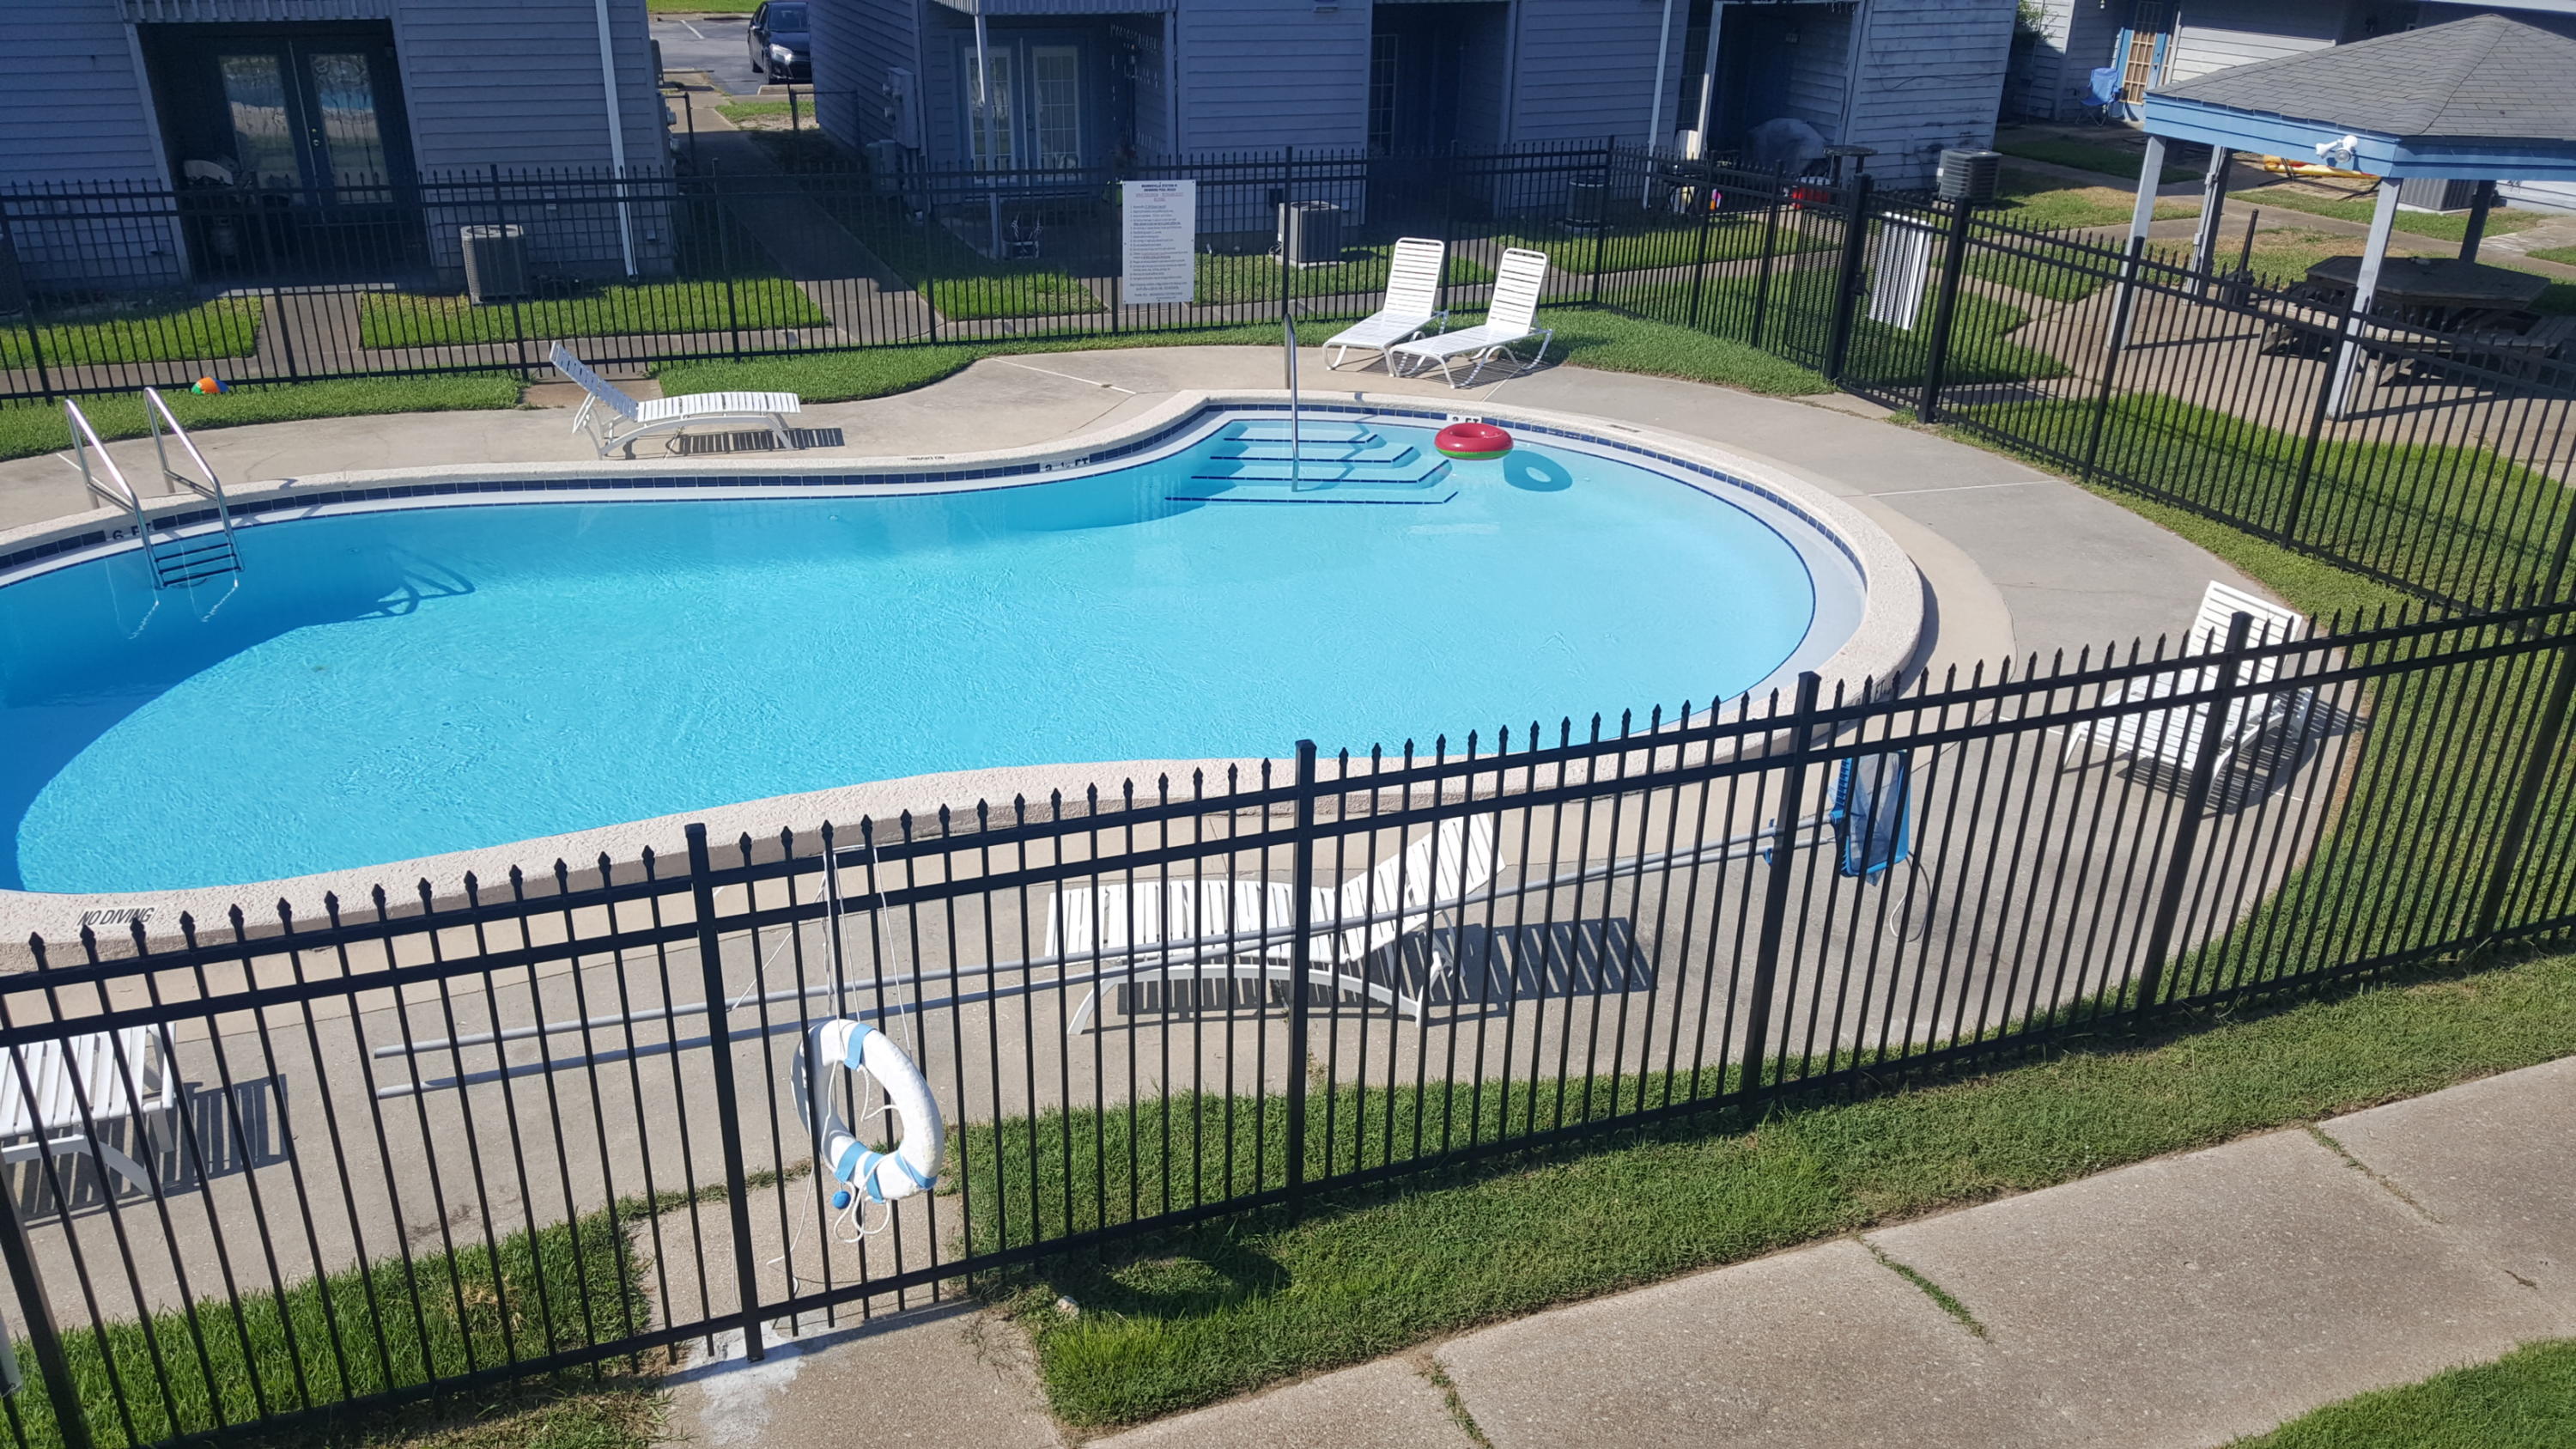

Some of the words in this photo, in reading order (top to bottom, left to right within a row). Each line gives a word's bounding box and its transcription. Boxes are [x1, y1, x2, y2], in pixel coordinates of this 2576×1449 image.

[1075, 457, 1089, 466] FT
[112, 529, 124, 539] 6
[131, 522, 151, 536] FT
[76, 910, 102, 926] NO
[99, 907, 155, 925] DIVING
